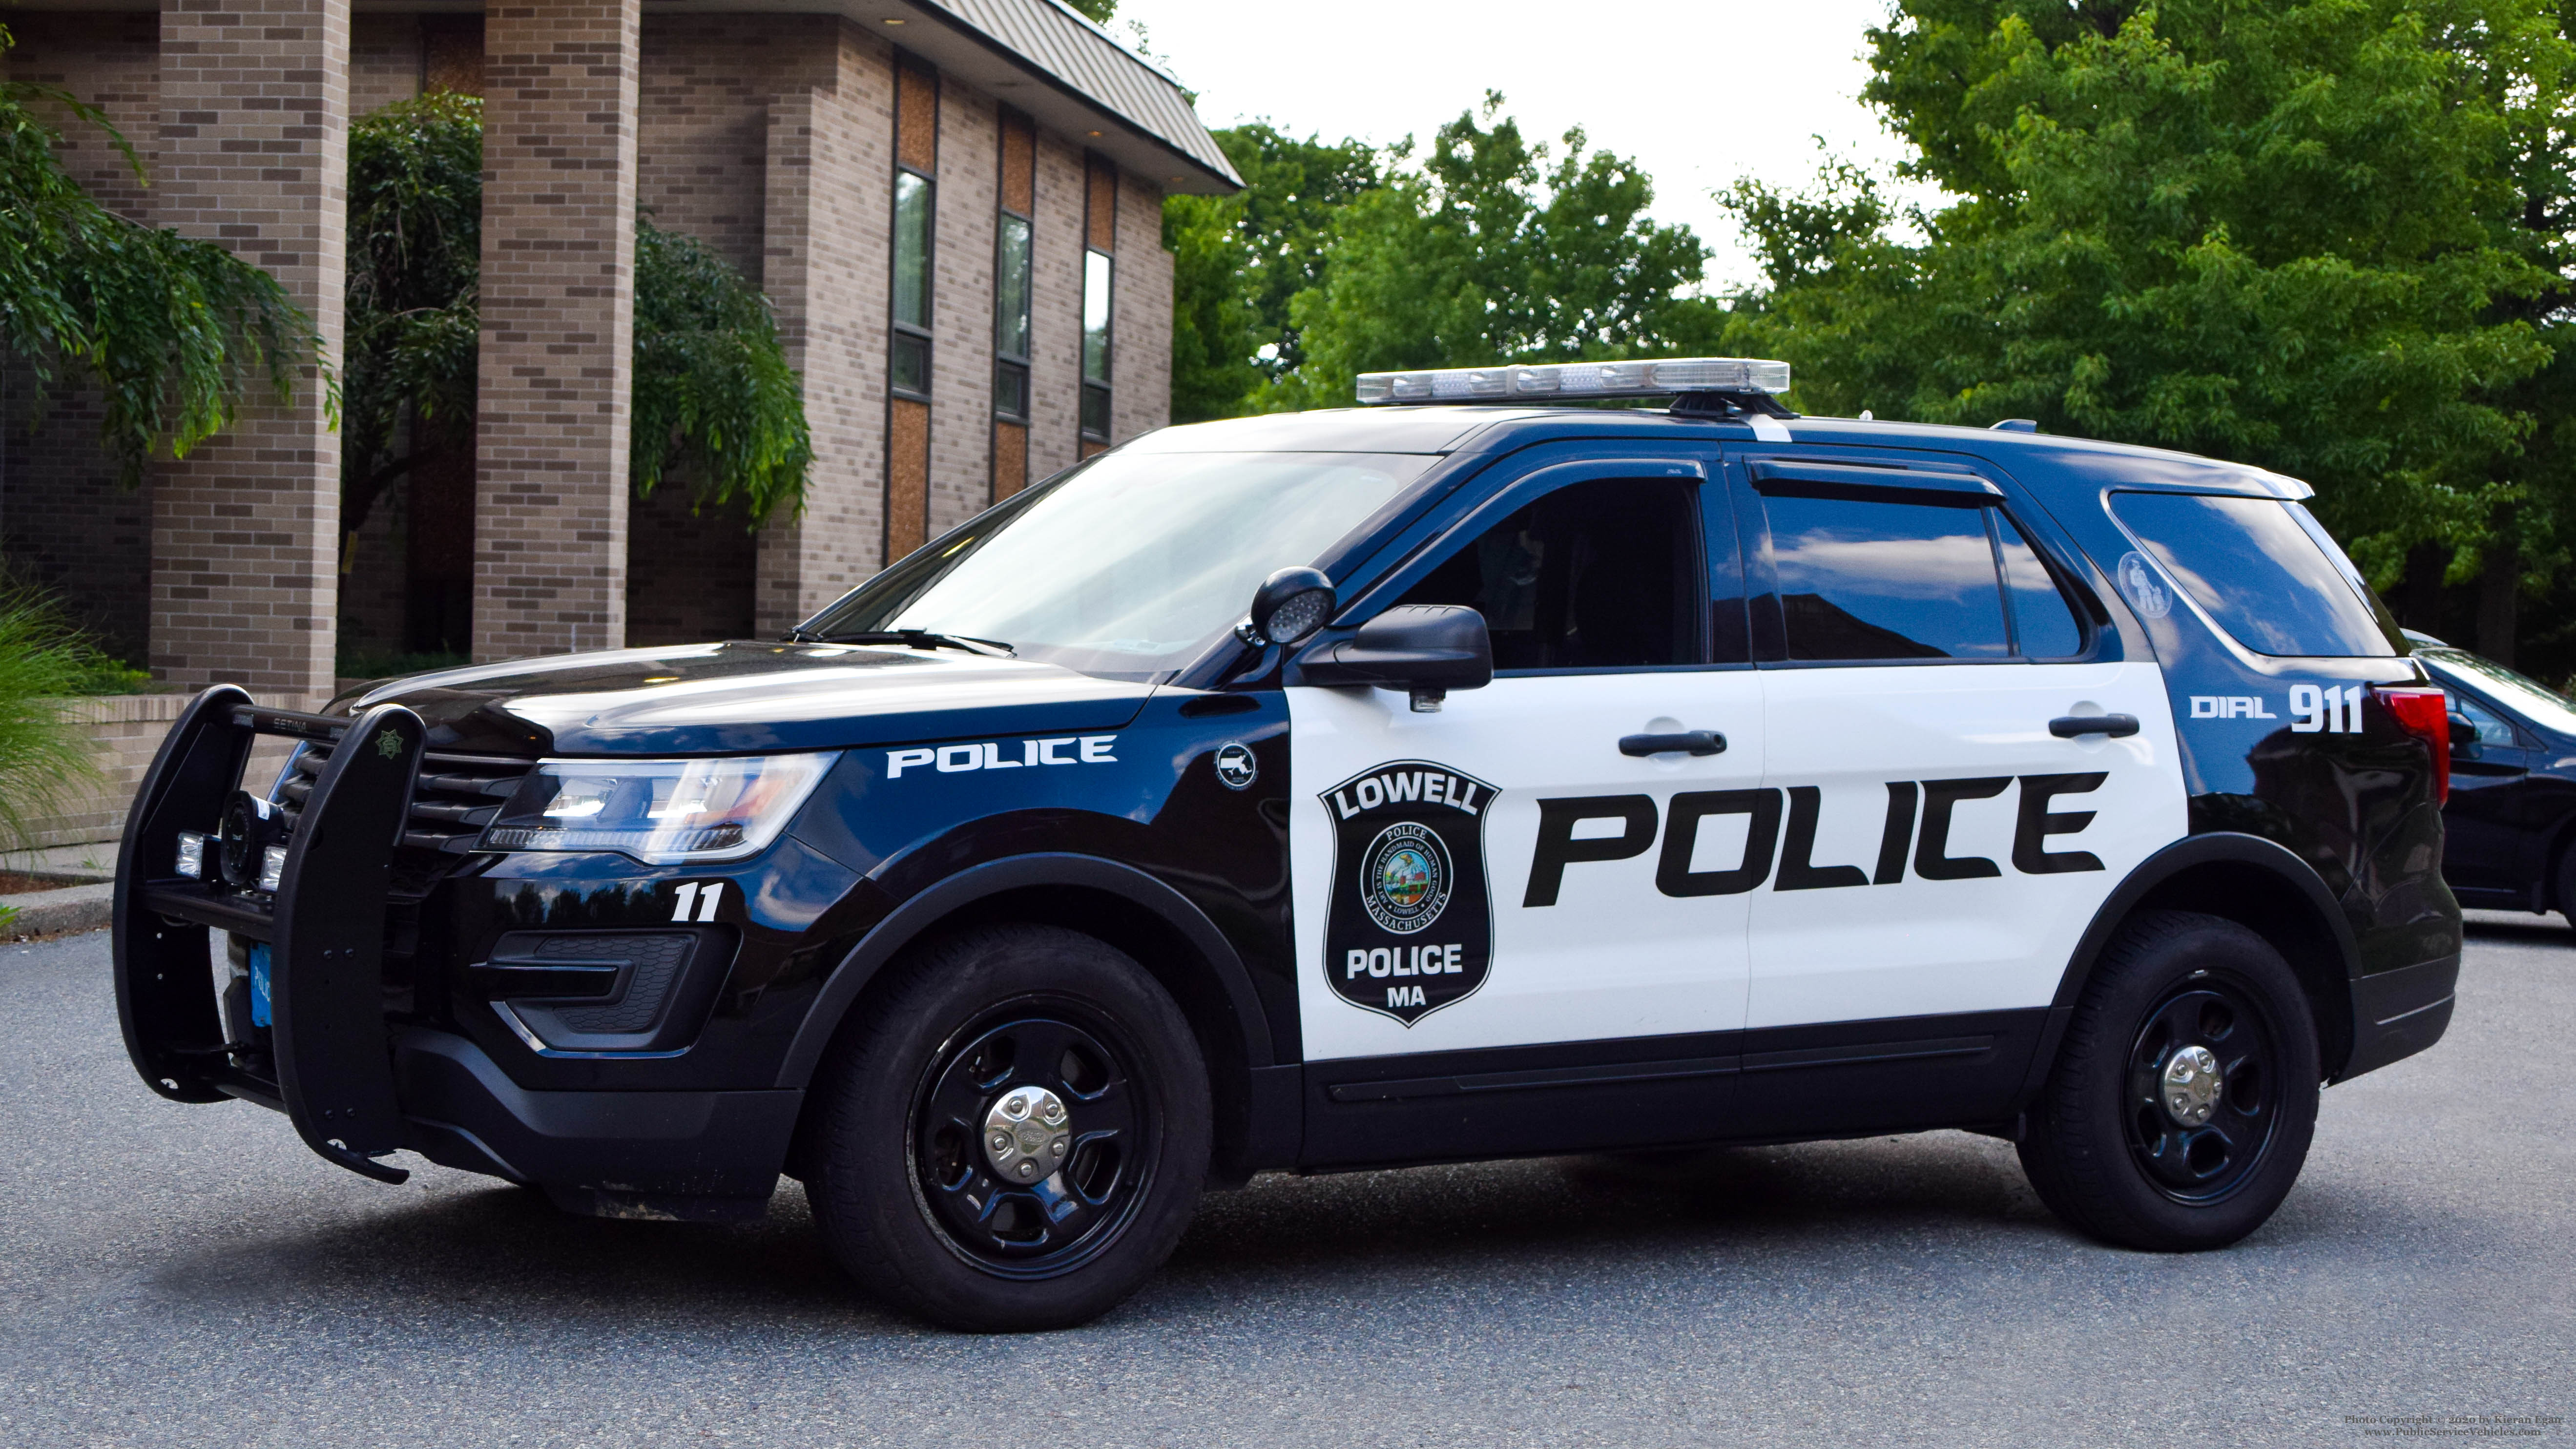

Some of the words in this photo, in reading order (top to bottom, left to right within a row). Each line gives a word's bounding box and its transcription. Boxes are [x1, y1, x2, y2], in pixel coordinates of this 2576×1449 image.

[2189, 696, 2277, 719] DIAL
[2289, 684, 2363, 733] 911
[886, 735, 1118, 779] POLICE
[1334, 771, 1478, 820] LOWELL
[1386, 826, 1427, 841] POLICE
[1522, 771, 2110, 908] POLICE
[1381, 841, 1415, 864] HANDMAID
[1424, 849, 1438, 878] HUMAN
[671, 882, 724, 921] 11
[1378, 890, 1389, 903] ART
[1425, 880, 1437, 902] GOOD
[1367, 892, 1447, 930] MASSACHUSETTS
[1393, 906, 1420, 914] LOWELL
[1348, 944, 1462, 979] POLICE
[1387, 986, 1426, 1008] MA
